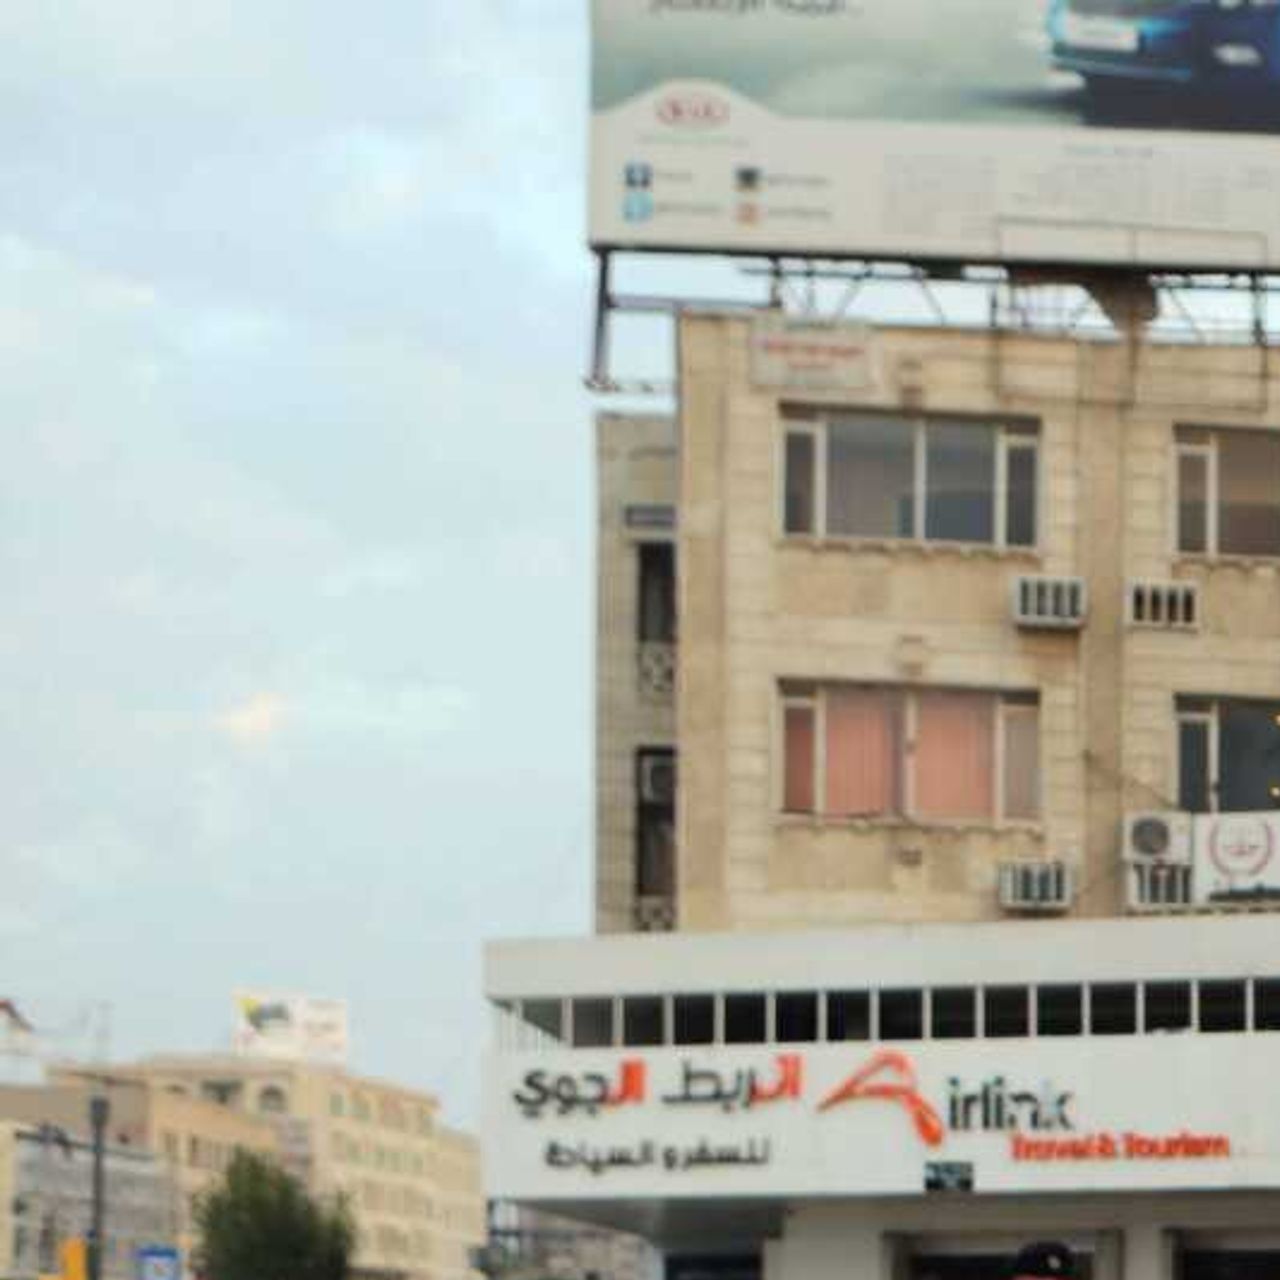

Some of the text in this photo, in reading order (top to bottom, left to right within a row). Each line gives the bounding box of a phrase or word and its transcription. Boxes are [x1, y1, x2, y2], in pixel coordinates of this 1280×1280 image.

[514, 1054, 804, 1118] الربط الجوي
[1123, 1128, 1230, 1158] Tourism
